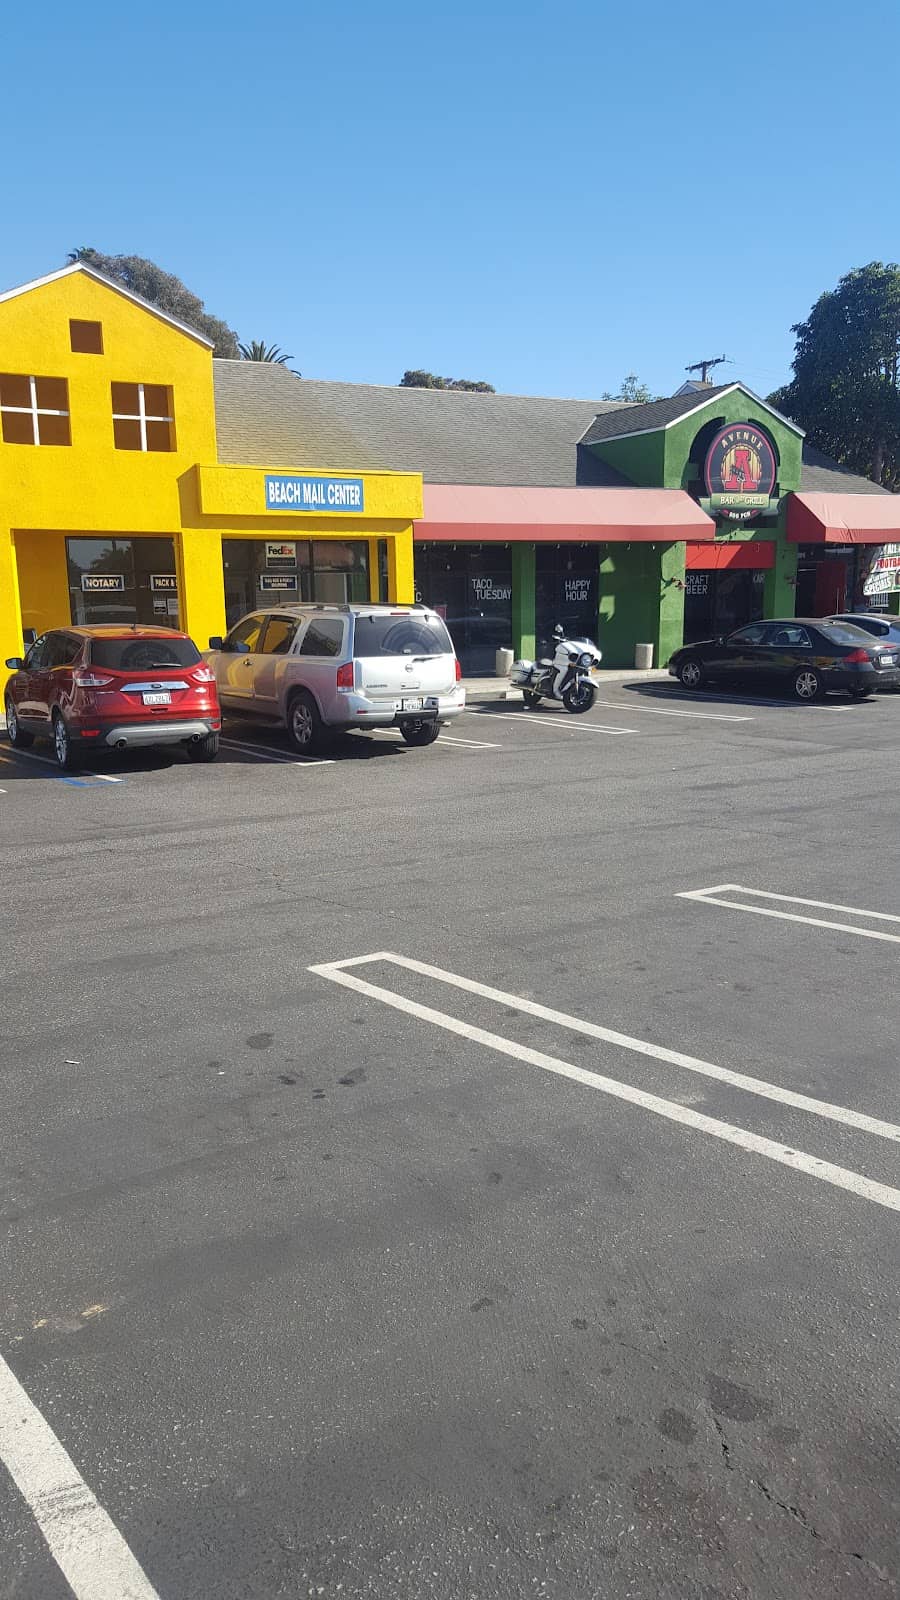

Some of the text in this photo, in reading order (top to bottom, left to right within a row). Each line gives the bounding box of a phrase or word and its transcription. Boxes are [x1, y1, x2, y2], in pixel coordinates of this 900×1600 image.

[721, 431, 764, 450] AVENUE
[268, 481, 361, 506] BEACH MAIL CENTER
[720, 496, 735, 505] BAR
[744, 497, 765, 506] GRILL
[268, 545, 294, 555] FedEx
[85, 579, 120, 588] NOTARY
[154, 578, 170, 587] PACK
[471, 578, 492, 589] TACO
[564, 580, 591, 591] HAPPY
[685, 575, 710, 585] CRAFT
[864, 577, 891, 592] SPECIALS
[475, 589, 512, 601] TUESDAY
[686, 584, 708, 595] BEER
[566, 590, 588, 601] HOUR
